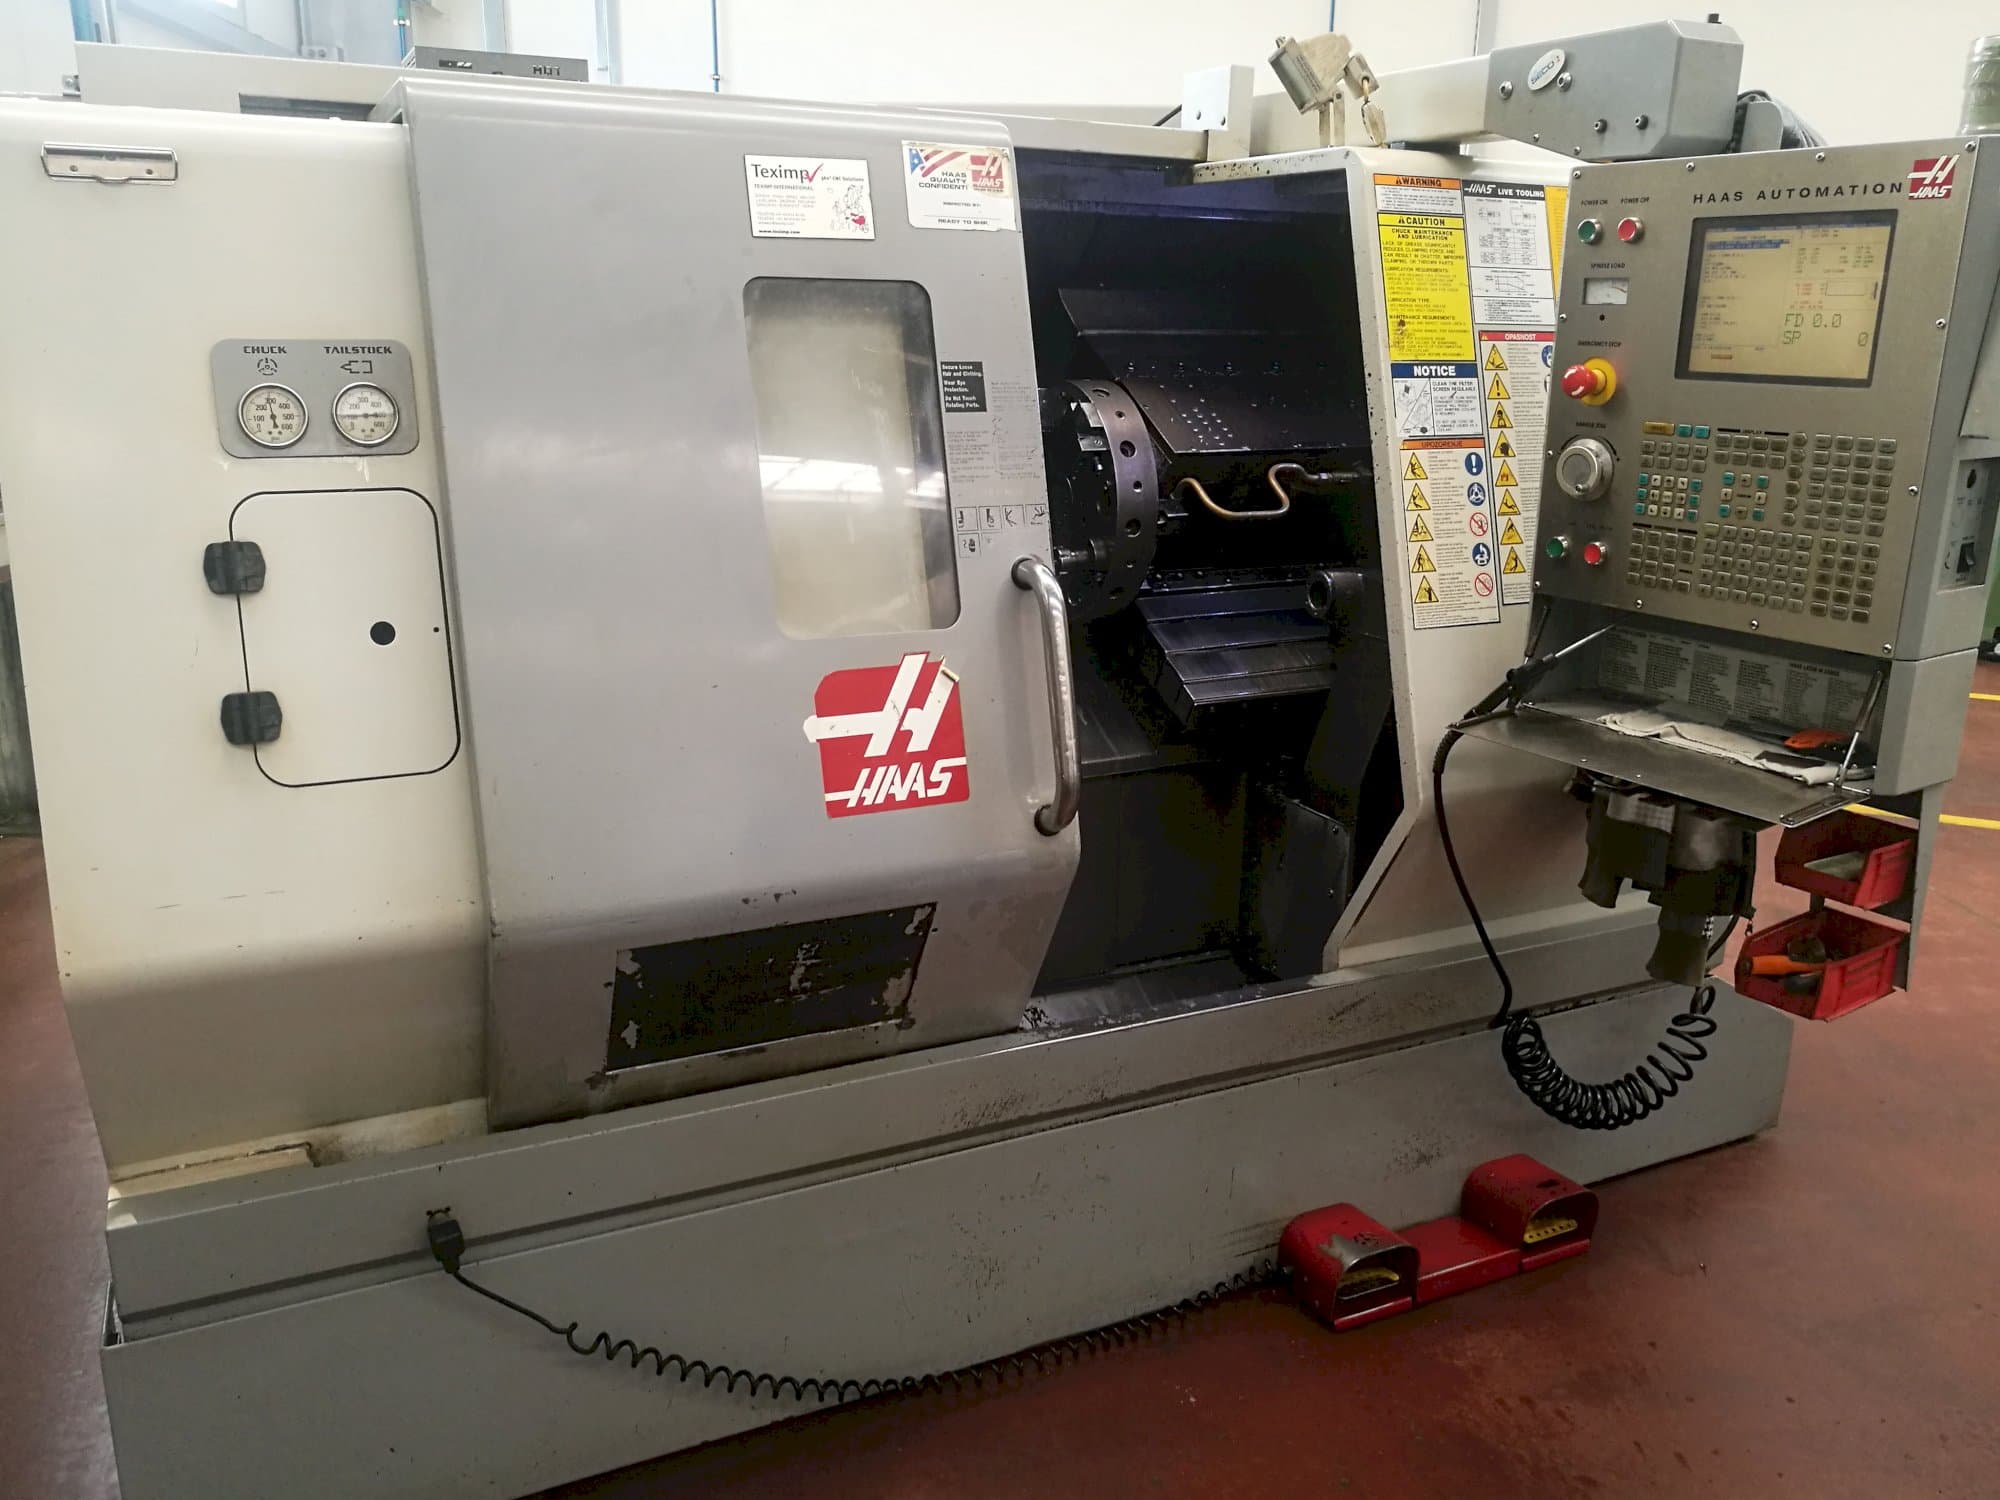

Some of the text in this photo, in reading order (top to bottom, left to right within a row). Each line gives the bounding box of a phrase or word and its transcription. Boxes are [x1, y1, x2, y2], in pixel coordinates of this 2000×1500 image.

[751, 164, 810, 183] Teximp
[1401, 177, 1442, 187] WARNING
[1464, 183, 1544, 197] HAAS LIVE TOOLING
[1693, 182, 1903, 205] HAAS AUTOMATION
[1908, 184, 1953, 200] HAAS
[1406, 217, 1445, 226] CAUTION
[1783, 313, 1842, 329] FD 0.0
[1505, 333, 1537, 341] OPASNOST
[1857, 331, 1869, 347] 0
[243, 345, 287, 354] CHUCK
[323, 346, 392, 354] TAILSTOCK
[1413, 365, 1457, 377] NOTICE
[278, 402, 290, 410] 400
[282, 413, 294, 421] 500
[824, 756, 967, 808] HAAS
